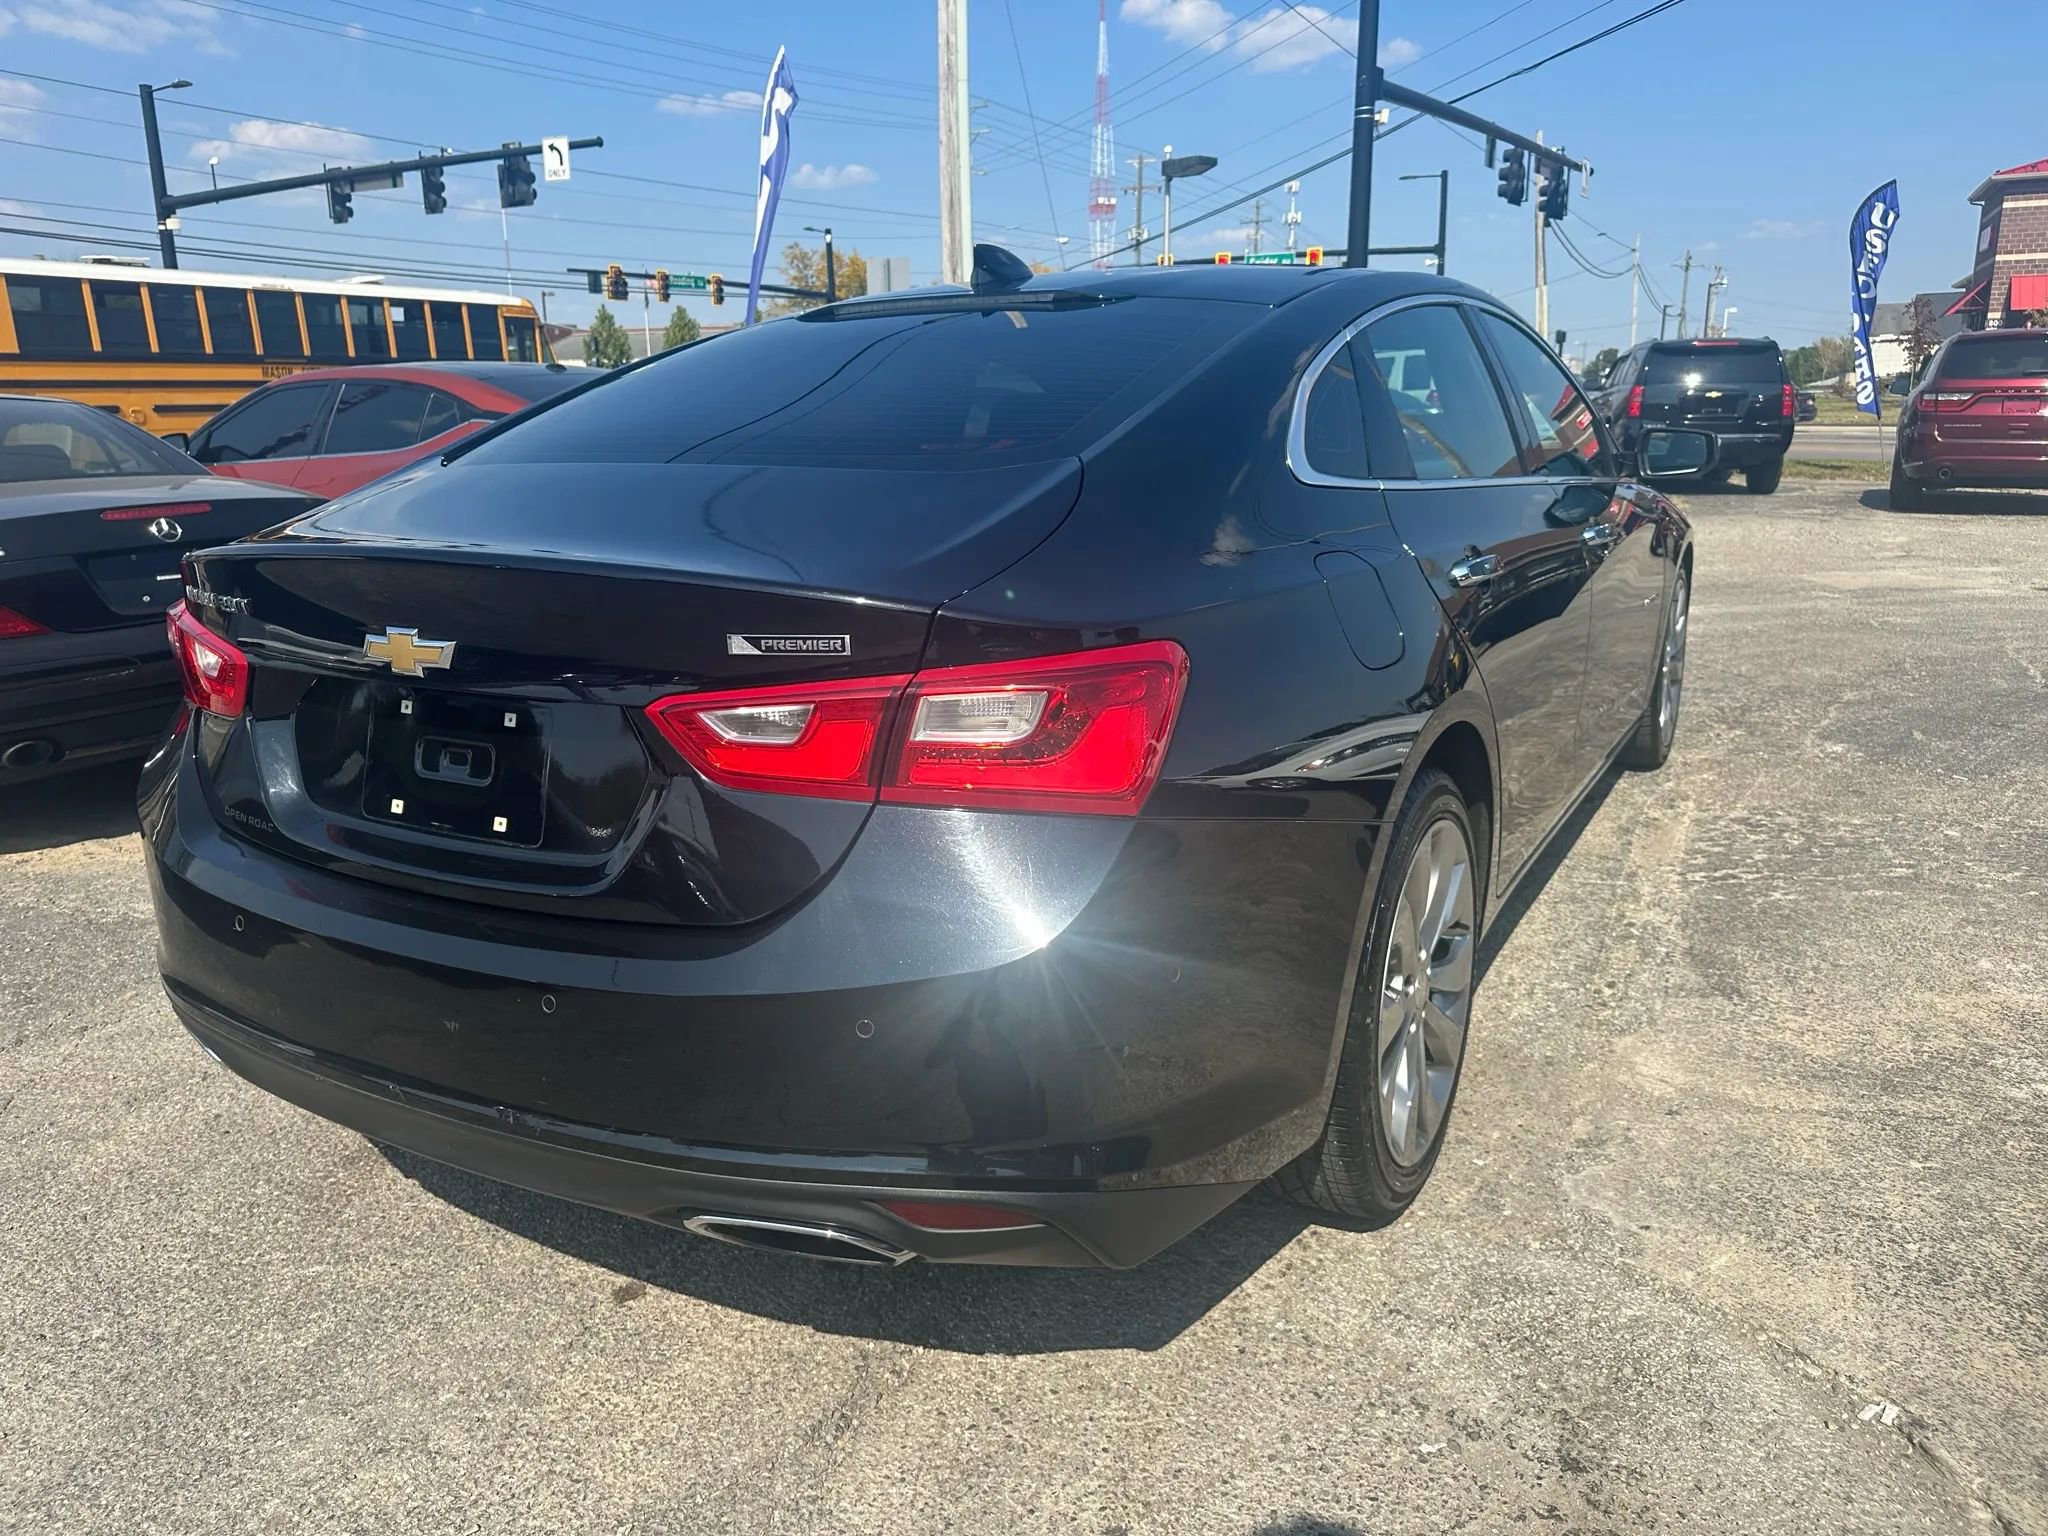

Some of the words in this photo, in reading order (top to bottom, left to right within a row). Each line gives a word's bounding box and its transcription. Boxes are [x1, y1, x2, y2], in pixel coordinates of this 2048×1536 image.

[548, 168, 567, 178] ONLY
[1857, 202, 1896, 299] USED
[262, 366, 294, 378] MASON
[761, 639, 842, 651] PREMIER
[224, 806, 247, 823] OPEN
